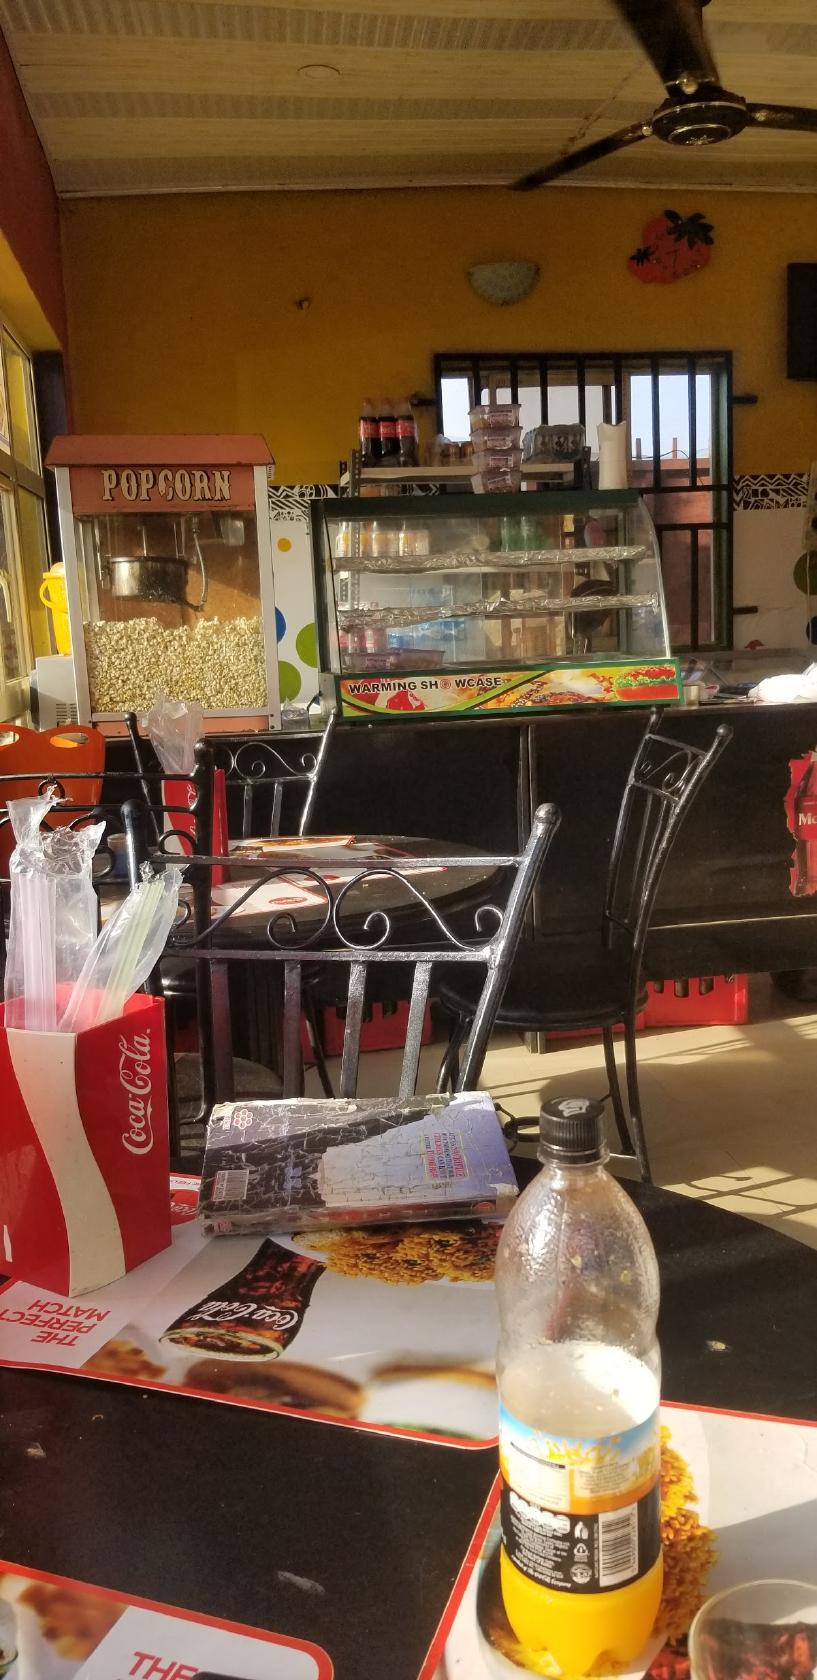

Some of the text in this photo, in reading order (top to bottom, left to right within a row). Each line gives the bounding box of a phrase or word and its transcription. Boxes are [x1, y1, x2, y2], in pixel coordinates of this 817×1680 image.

[101, 468, 231, 501] POPCORN
[349, 681, 417, 694] WARMING
[118, 1029, 153, 1155] Coca-Cola
[27, 1299, 111, 1322] MATCH
[188, 1301, 299, 1331] Coca-Cola
[30, 1330, 79, 1347] THE
